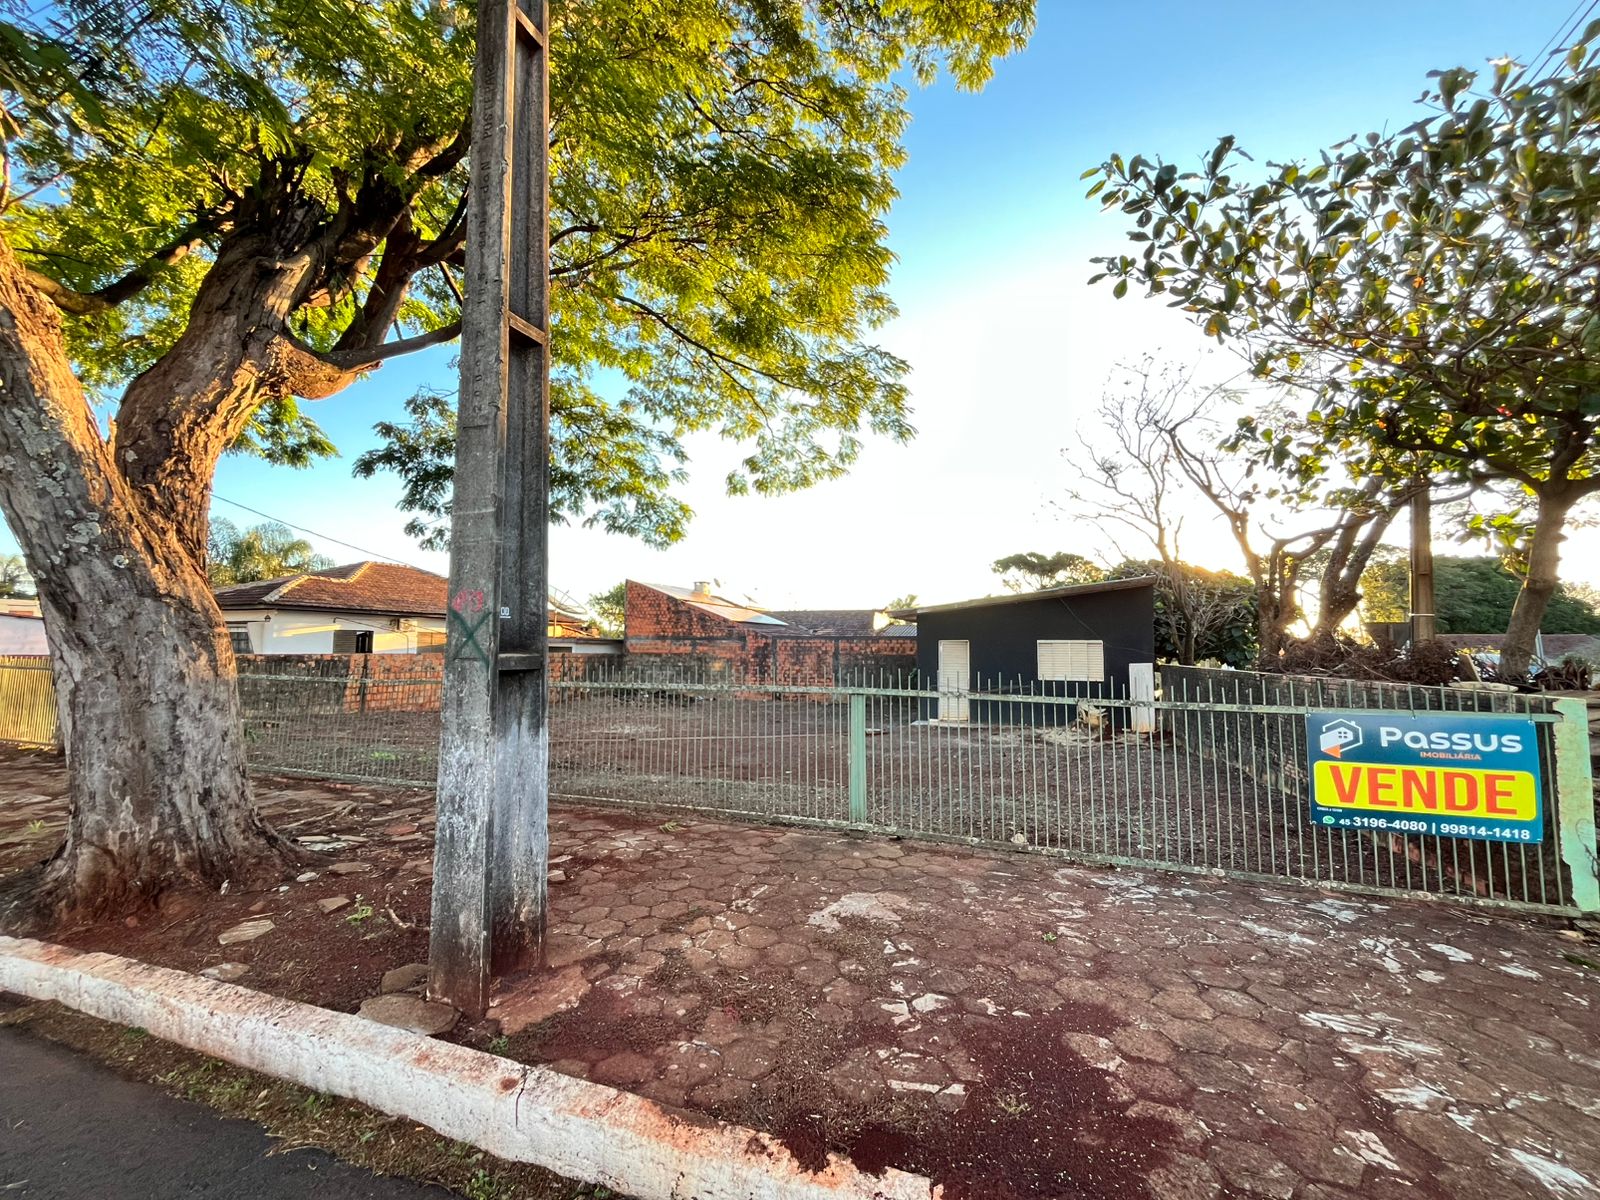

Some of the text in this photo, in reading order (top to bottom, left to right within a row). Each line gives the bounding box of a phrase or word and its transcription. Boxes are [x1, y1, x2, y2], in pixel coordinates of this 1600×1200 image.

[1380, 726, 1523, 753] Passus
[1420, 751, 1482, 761] IMOBILIÁRIA
[1329, 765, 1518, 815] VENDE
[1339, 818, 1351, 826] 45
[1353, 816, 1428, 832] 3196-4080
[1440, 823, 1531, 840] 99814-1418
